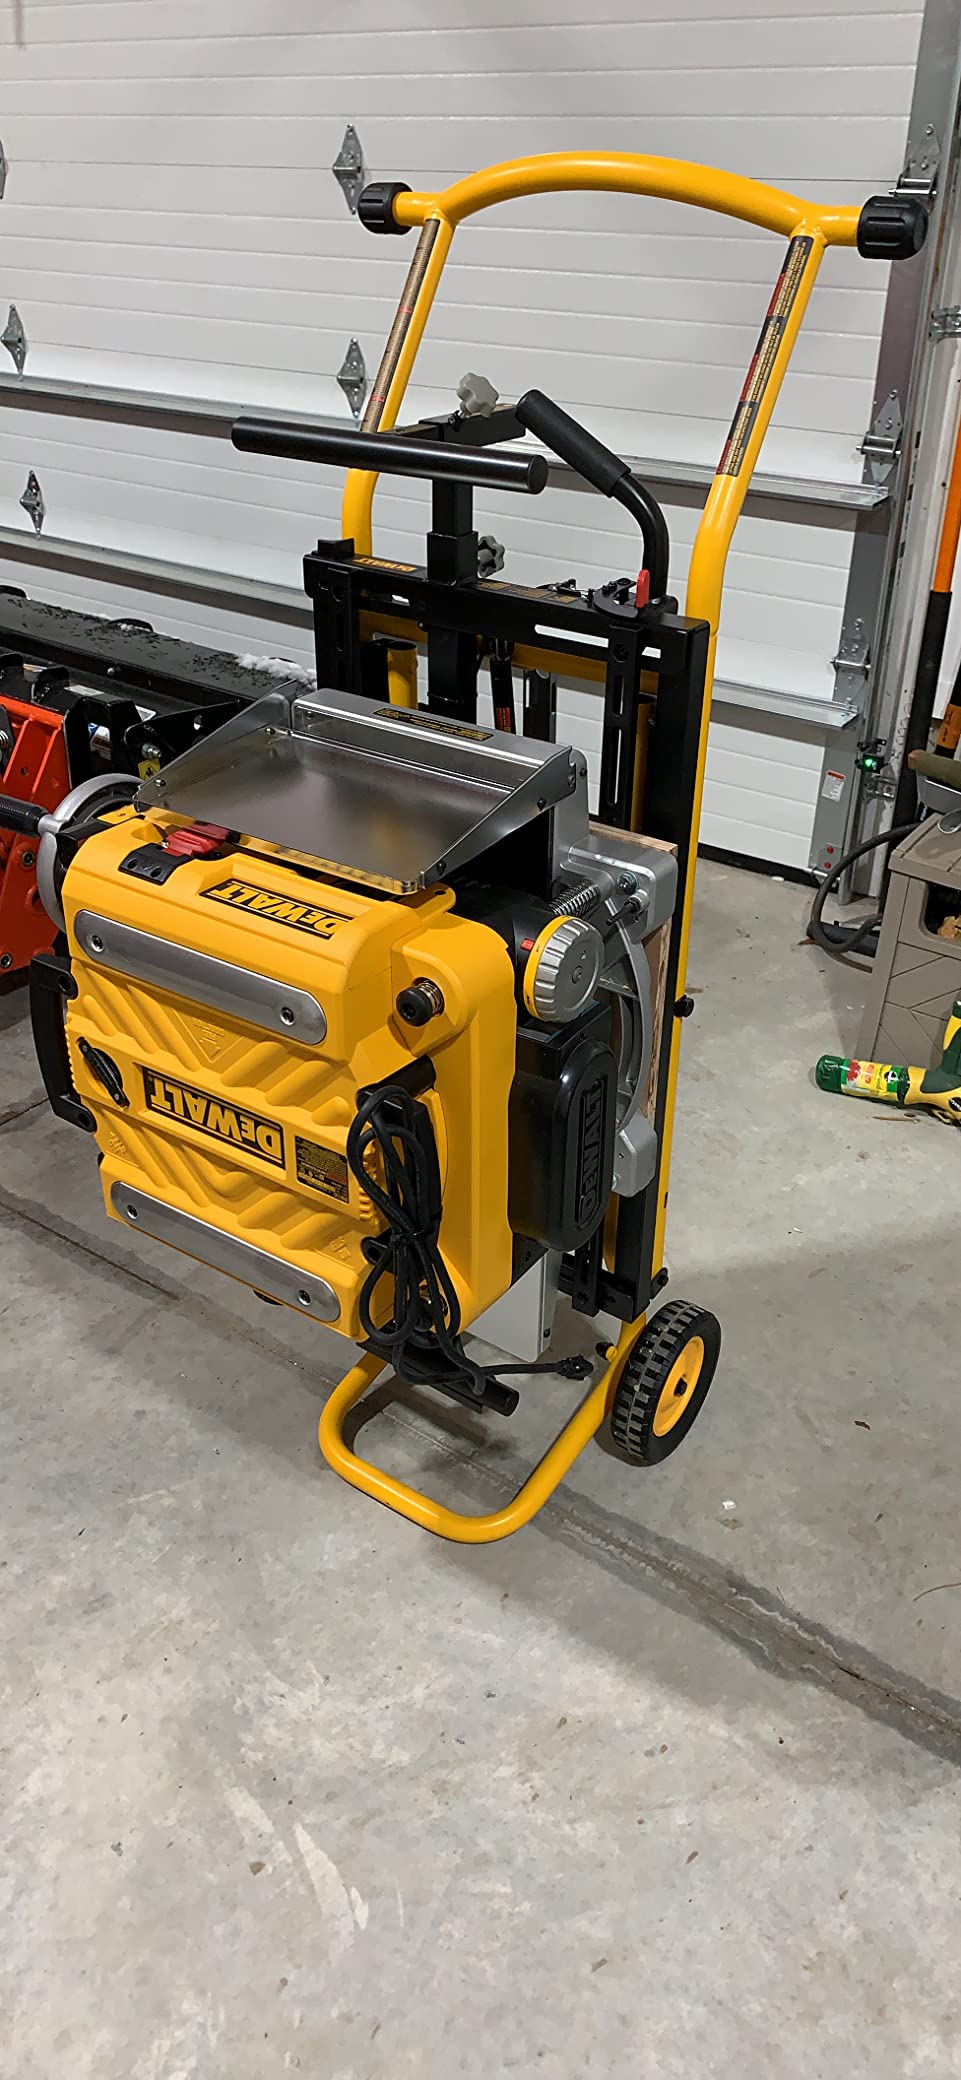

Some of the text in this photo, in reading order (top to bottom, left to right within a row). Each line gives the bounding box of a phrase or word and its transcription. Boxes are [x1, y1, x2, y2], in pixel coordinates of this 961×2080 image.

[210, 883, 339, 933] DEWALT
[150, 1078, 281, 1159] DEWALT
[581, 1088, 602, 1222] DEWALT
